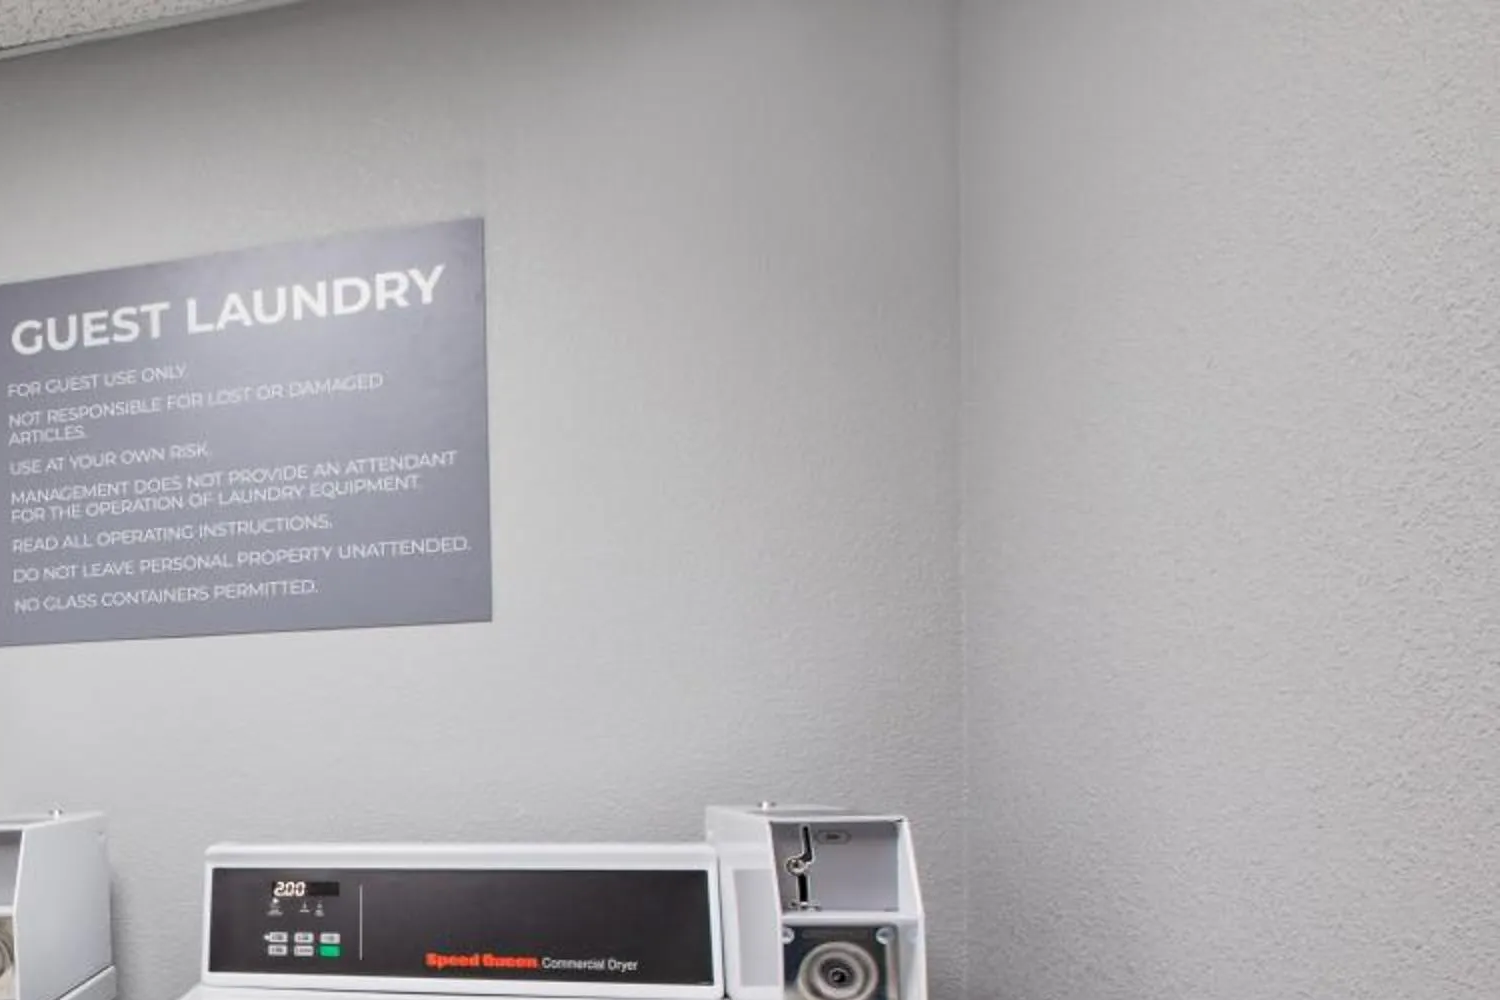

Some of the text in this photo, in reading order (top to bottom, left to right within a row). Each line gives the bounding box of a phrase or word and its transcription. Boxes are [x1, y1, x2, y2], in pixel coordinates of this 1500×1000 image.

[11, 264, 446, 356] GUEST LAUNDRY
[7, 382, 41, 398] FOR
[45, 374, 100, 394] GUEST
[104, 370, 137, 388] USE
[8, 372, 384, 429] NOT RESPONSIBLE FOR LOST OR DAMAGED
[9, 459, 41, 476] USE
[45, 457, 64, 472] AT
[69, 451, 117, 470] YOUR
[120, 447, 165, 465] OWN
[11, 450, 458, 506] MANAGEMENT DOES NOT PROVIDE AN ATTENDANT
[11, 507, 45, 524] FOR
[50, 504, 81, 520] THE
[85, 495, 183, 517] OPERATION
[188, 492, 214, 508] OF
[218, 484, 306, 506] LAUNDRY
[13, 536, 58, 553] READ
[62, 534, 93, 549] ALL
[97, 525, 193, 547] OPERATING
[13, 536, 472, 583] DO NOT LEAVE PERSONAL PROPERTY UNATTENDED.
[14, 579, 321, 615] NO GLASS CONTAINERS PERMITTED.
[425, 953, 480, 970] Speed
[541, 957, 605, 971] Commercial
[607, 959, 639, 973] Dryer
